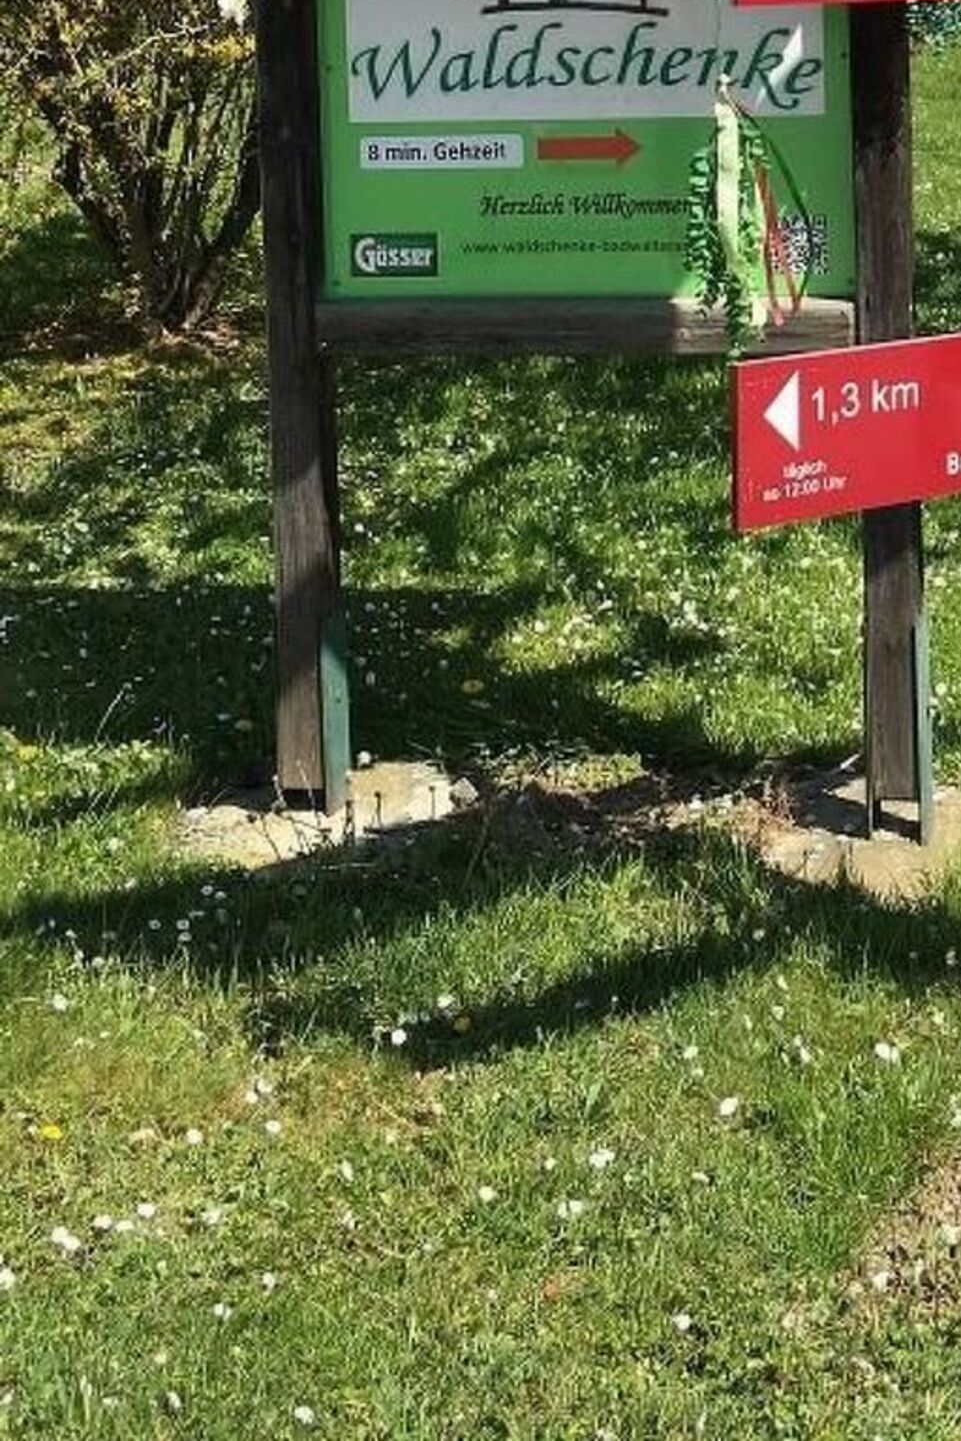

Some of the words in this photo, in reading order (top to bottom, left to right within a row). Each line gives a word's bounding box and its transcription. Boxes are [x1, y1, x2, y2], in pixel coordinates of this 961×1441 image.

[351, 20, 824, 111] Waldschenke
[368, 143, 380, 161] 8
[385, 142, 428, 161] min.
[433, 141, 506, 161] Gehzeit
[480, 193, 567, 218] Herzlich
[354, 237, 434, 274] Gösser
[811, 380, 860, 427] 1,3
[870, 377, 921, 414] km
